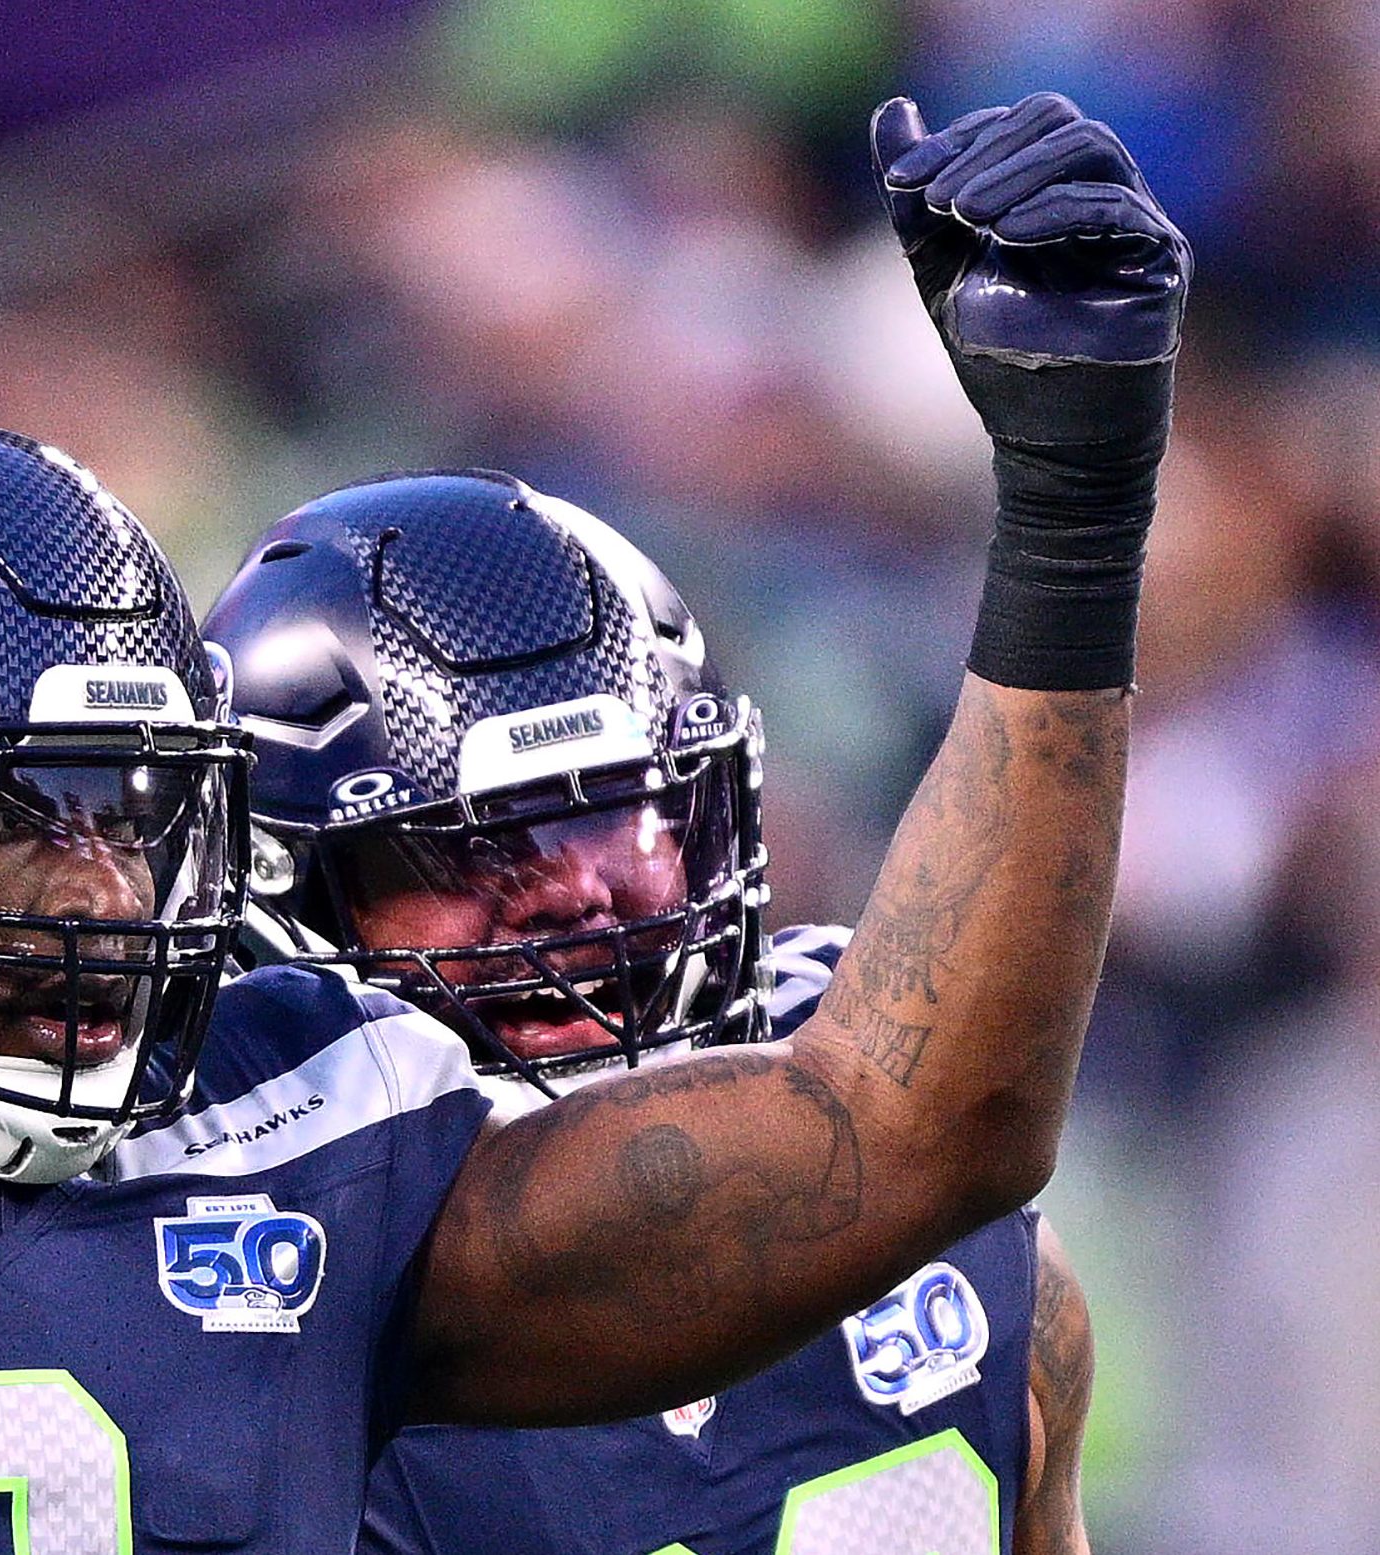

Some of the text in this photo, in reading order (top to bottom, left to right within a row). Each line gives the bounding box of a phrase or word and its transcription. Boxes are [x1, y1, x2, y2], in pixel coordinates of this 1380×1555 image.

[86, 680, 168, 708] SEAHAWKS
[508, 707, 605, 752] SEAHAWKS
[330, 787, 411, 822] OAKLEY
[183, 1093, 326, 1159] SEAHAWKS
[161, 1217, 322, 1311] 50
[853, 1271, 974, 1396] 50
